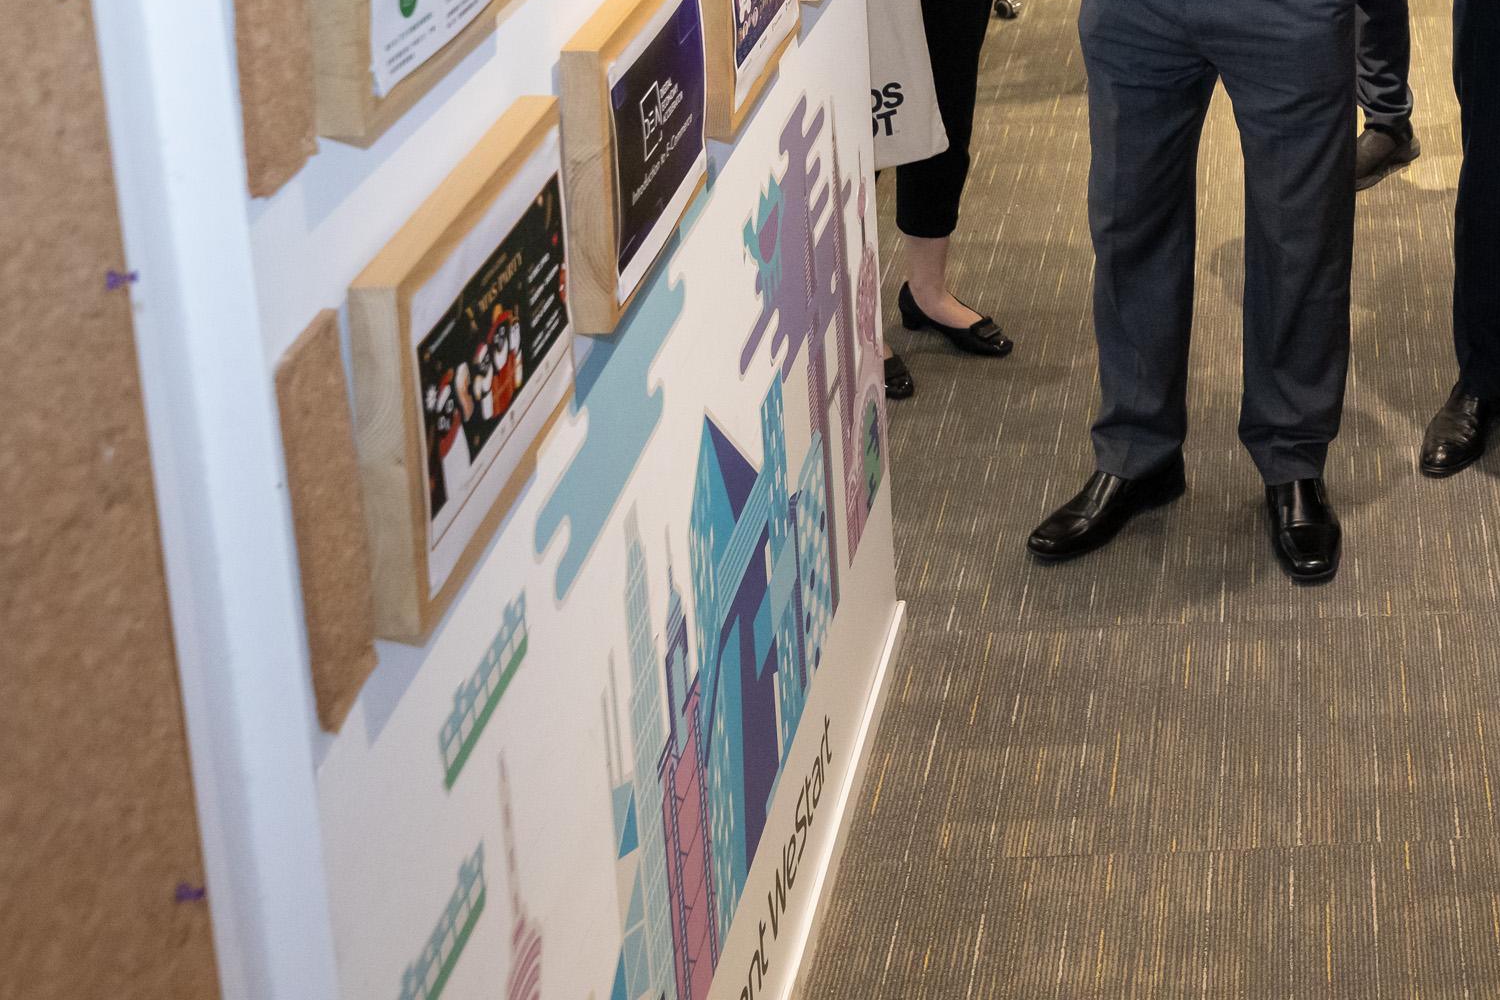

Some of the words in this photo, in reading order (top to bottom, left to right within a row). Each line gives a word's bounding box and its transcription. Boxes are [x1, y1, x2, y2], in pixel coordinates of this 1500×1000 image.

[661, 83, 678, 112] ECONOMY
[632, 160, 660, 206] Introduction
[666, 113, 693, 157] E-Commerce
[768, 714, 832, 941] WeStart
